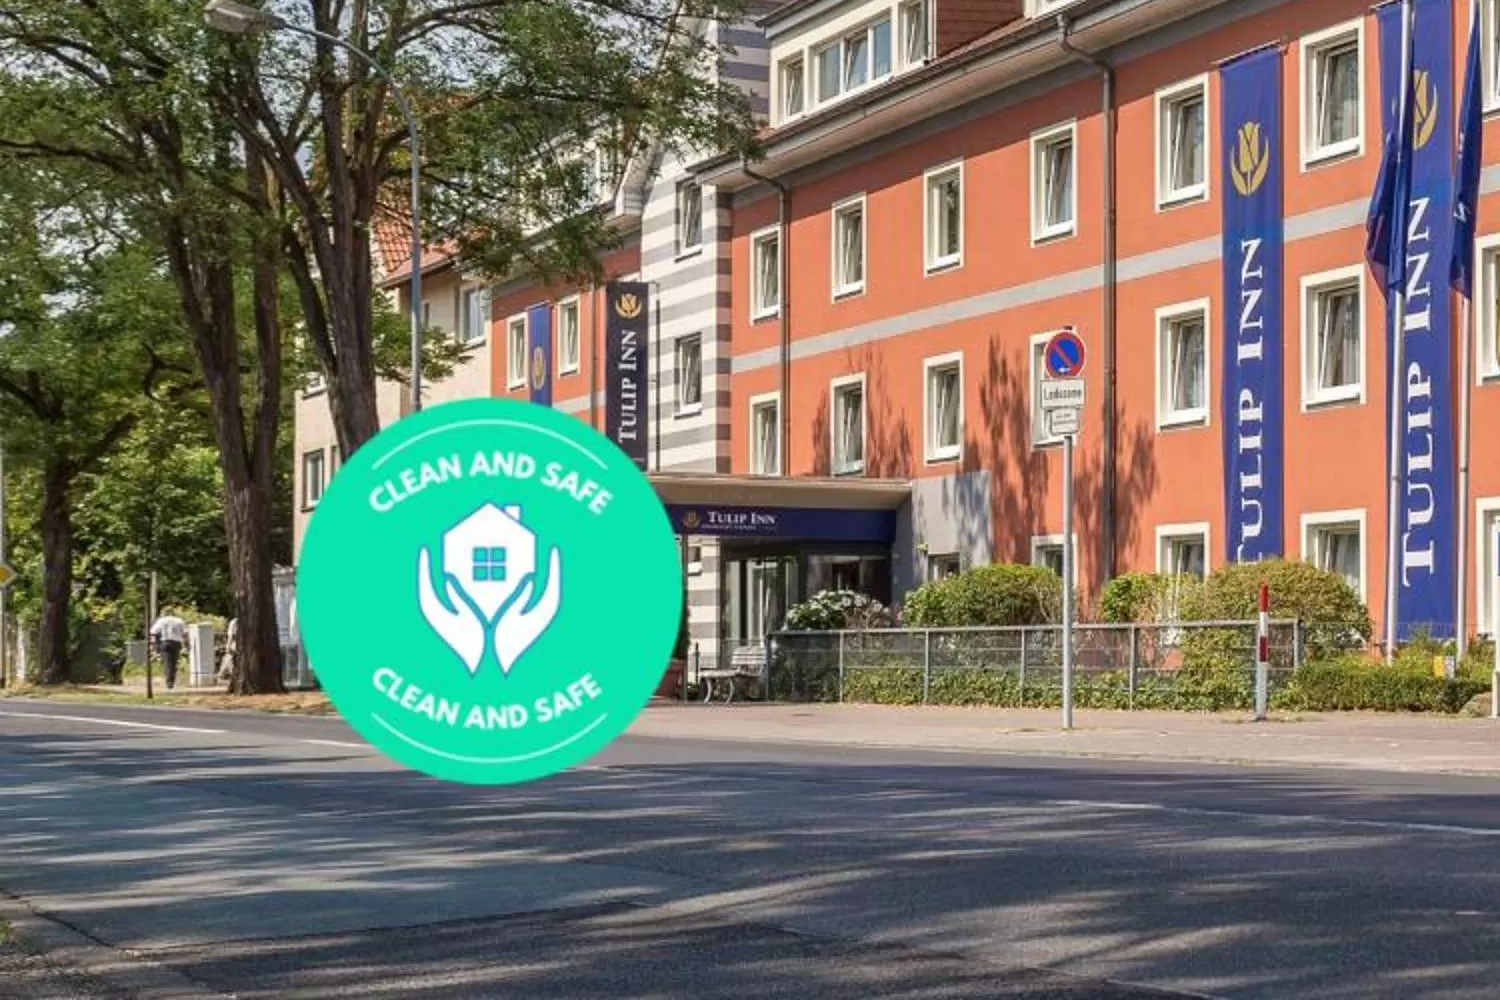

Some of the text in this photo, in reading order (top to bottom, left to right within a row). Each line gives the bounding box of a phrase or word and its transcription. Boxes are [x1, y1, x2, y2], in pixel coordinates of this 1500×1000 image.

[1237, 238, 1263, 367] INN
[618, 330, 637, 443] TULIP INN
[1402, 198, 1435, 587] TULIP INN
[707, 511, 748, 524] TULIP
